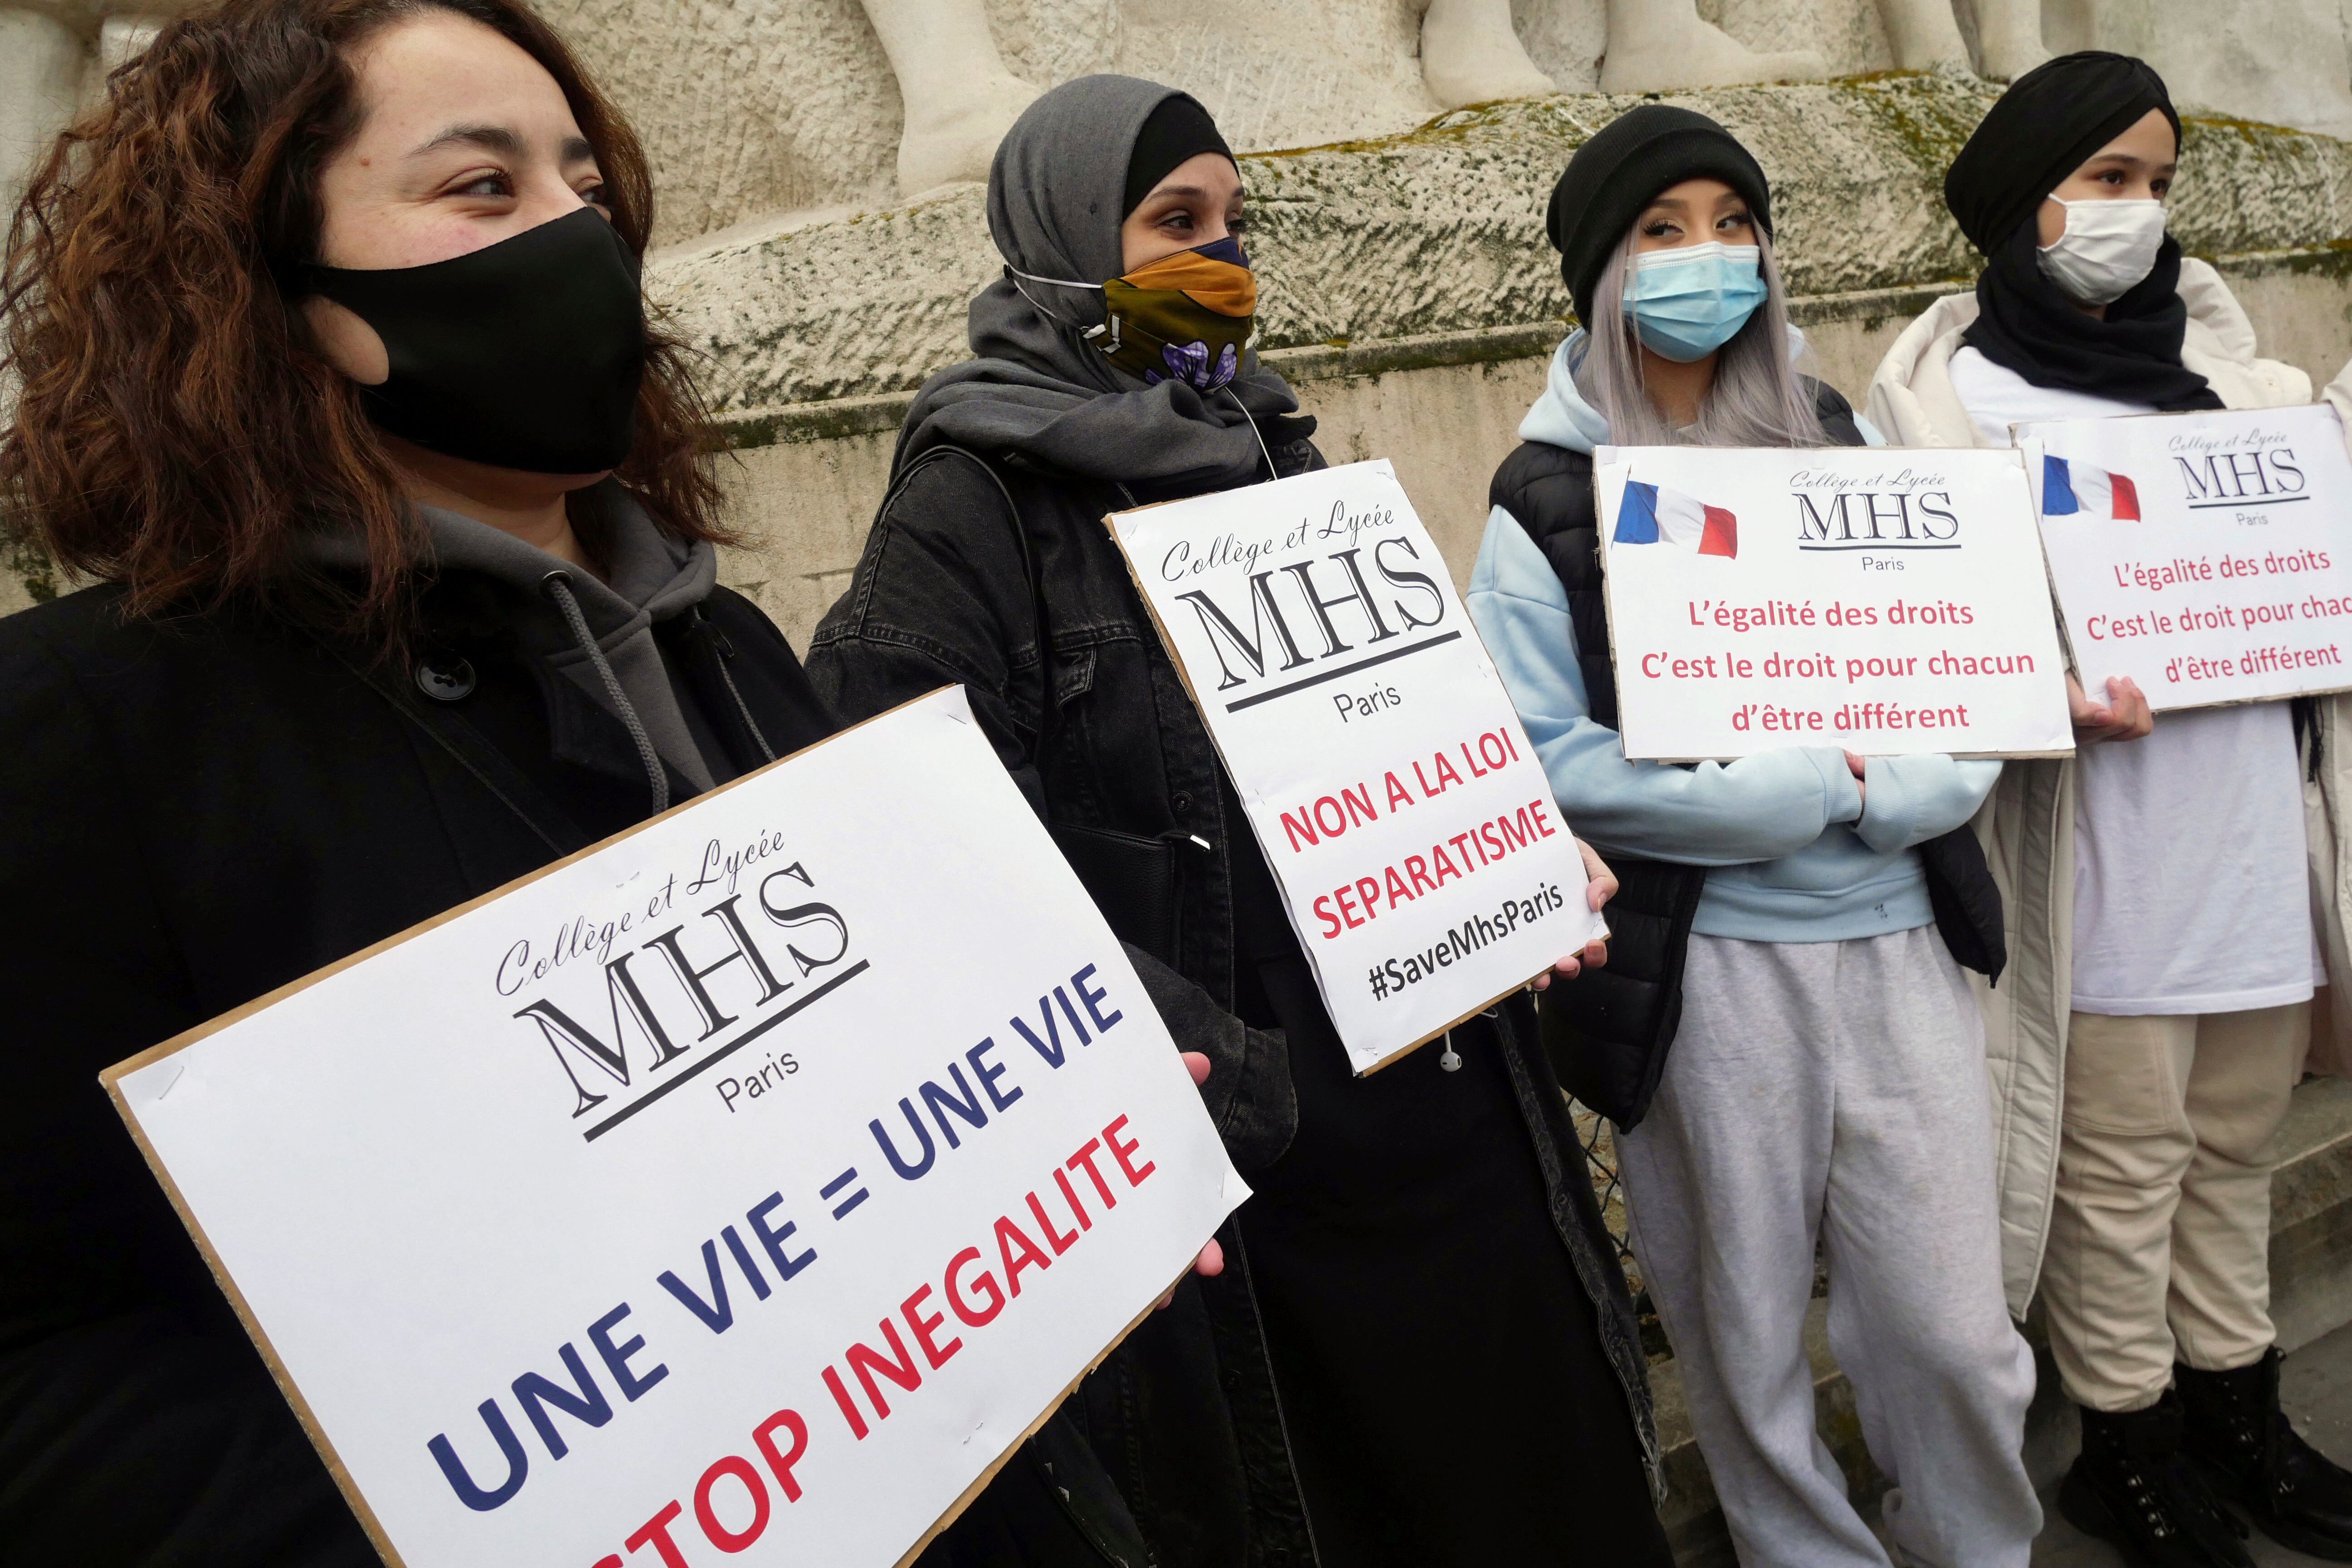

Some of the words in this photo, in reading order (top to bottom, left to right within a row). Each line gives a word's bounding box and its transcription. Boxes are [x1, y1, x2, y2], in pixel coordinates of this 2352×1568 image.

[2169, 436, 2219, 454] Collège
[2225, 435, 2238, 447] et
[2243, 428, 2286, 450] Lycée
[1790, 471, 1857, 493] Collège
[1866, 474, 1883, 486] et
[1886, 469, 1945, 492] Lycée
[2173, 449, 2304, 499] MHS
[1792, 492, 1958, 540] MHS
[2236, 513, 2268, 525] Paris
[1162, 534, 1273, 581] Collège
[1281, 517, 1311, 550] et
[1317, 500, 1394, 546] Lycée
[1862, 557, 1904, 570] Paris
[2114, 556, 2212, 591] L’égalité
[2220, 554, 2259, 578] des
[2265, 549, 2330, 573] droits
[1174, 536, 1444, 691] MHS
[1689, 601, 1815, 632] L’égalité
[1826, 602, 1877, 626] des
[1888, 599, 1973, 624] droits
[2087, 615, 2147, 640] C’est
[2151, 611, 2172, 634] le
[2180, 605, 2235, 631] droit
[2242, 604, 2293, 631] pour
[1642, 652, 1717, 678] C’est
[1726, 652, 1752, 678] le
[1764, 652, 1837, 677] droit
[1846, 658, 1917, 684] pour
[1929, 650, 2034, 675] chacun
[2166, 657, 2234, 682] d’être
[2241, 644, 2341, 674] différent
[1333, 682, 1401, 723] Paris
[1732, 704, 1823, 731] d’être
[1834, 703, 1969, 730] différent
[1280, 783, 1378, 853] NON
[1384, 771, 1415, 813] A
[1412, 752, 1464, 798] LA
[1460, 727, 1519, 778] LOI
[1313, 799, 1555, 939] SEPARATISME
[496, 913, 632, 996] Collège
[642, 873, 677, 923] et
[686, 829, 784, 899] Lycée
[1369, 882, 1563, 1001] #SaveMhsParis
[512, 861, 848, 1119] MHS
[716, 1053, 799, 1113] Paris
[427, 1302, 669, 1512] UNE
[657, 1191, 818, 1334] VIE
[819, 1167, 869, 1221] =
[868, 1037, 1024, 1181] UNE
[1009, 963, 1123, 1069] VIE
[592, 1409, 808, 1568] TOP
[821, 1113, 1156, 1441] INEGALITE
